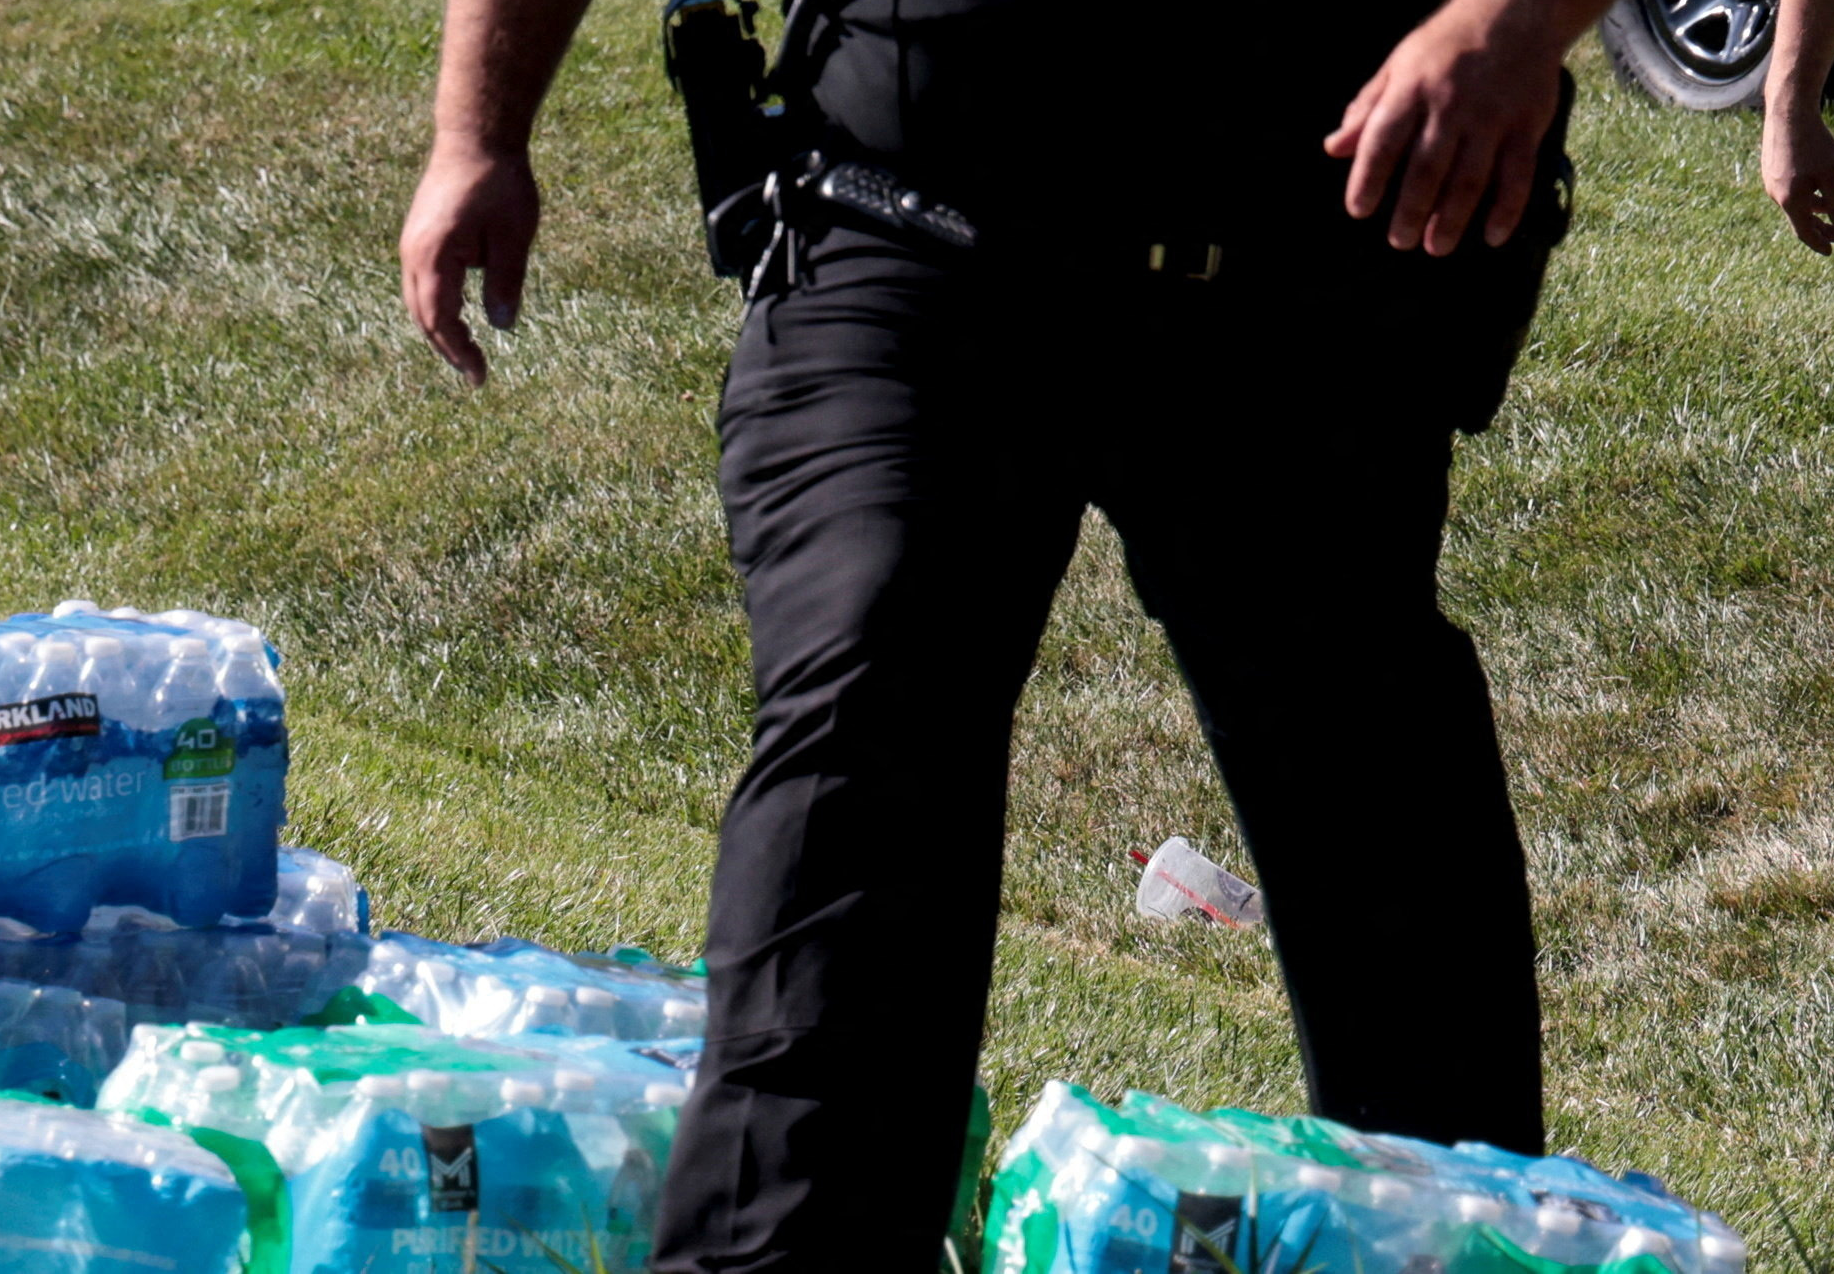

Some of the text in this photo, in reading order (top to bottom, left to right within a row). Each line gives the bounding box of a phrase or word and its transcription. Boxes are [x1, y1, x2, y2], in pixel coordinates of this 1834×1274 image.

[175, 728, 217, 750] 40
[60, 769, 148, 805] water
[378, 1147, 421, 1179] 40
[1109, 1204, 1158, 1237] 40
